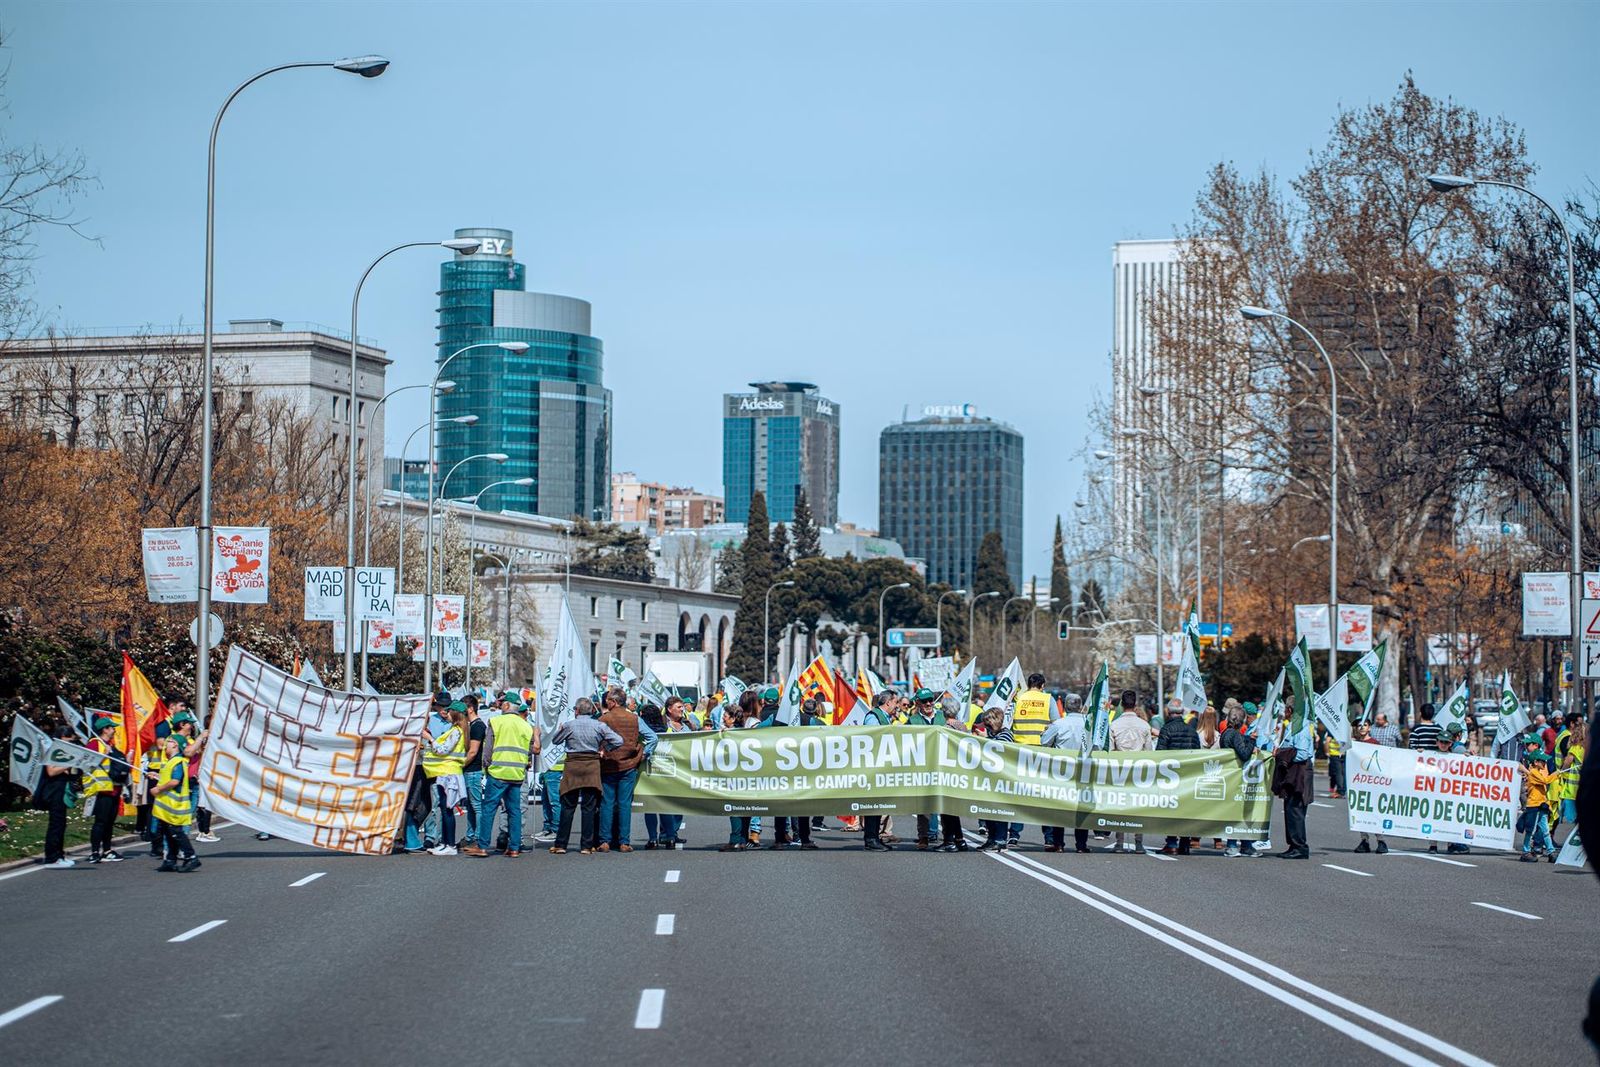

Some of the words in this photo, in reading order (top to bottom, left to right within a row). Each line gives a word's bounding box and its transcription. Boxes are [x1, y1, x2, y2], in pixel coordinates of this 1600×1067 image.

[482, 237, 506, 255] EY
[740, 396, 785, 410] Adeslas
[219, 538, 264, 549] Stephanie
[215, 571, 232, 581] EN
[232, 571, 264, 580] BUSCA
[307, 570, 343, 584] MAD
[356, 571, 387, 585] CUL
[215, 580, 229, 588] DE
[230, 580, 243, 588] LA
[243, 580, 265, 588] VIDA
[320, 584, 343, 597] RID
[361, 584, 381, 598] TU
[370, 598, 391, 612] RA
[452, 649, 464, 657] RA
[1333, 713, 1341, 723] de
[330, 732, 421, 783] 2030
[690, 738, 763, 772] NOS
[775, 733, 926, 772] SOBRAN
[938, 733, 1005, 774] LOS
[1016, 747, 1181, 790] MOTIVOS
[1417, 756, 1514, 783] ASOCIACIÓN
[207, 751, 251, 807] EL
[1353, 773, 1393, 786] ADECCU
[690, 776, 789, 791] DEFENDEMOS
[794, 776, 811, 789] EL
[815, 773, 872, 791] CAMPO,
[875, 771, 968, 789] DEFENDEMOS
[973, 776, 995, 791] LA
[995, 779, 1101, 805] ALIMENTACIÓN
[1102, 790, 1128, 806] DE
[1130, 791, 1179, 809] TODOS
[1414, 775, 1436, 793] EN
[1440, 778, 1512, 803] DEFENSA
[1243, 794, 1271, 802] Uniones
[1349, 789, 1373, 813] DEL
[1377, 792, 1430, 819] CAMPO
[1433, 798, 1454, 822] DE
[1456, 802, 1512, 830] CUENCA
[312, 824, 396, 856] CUENCA
